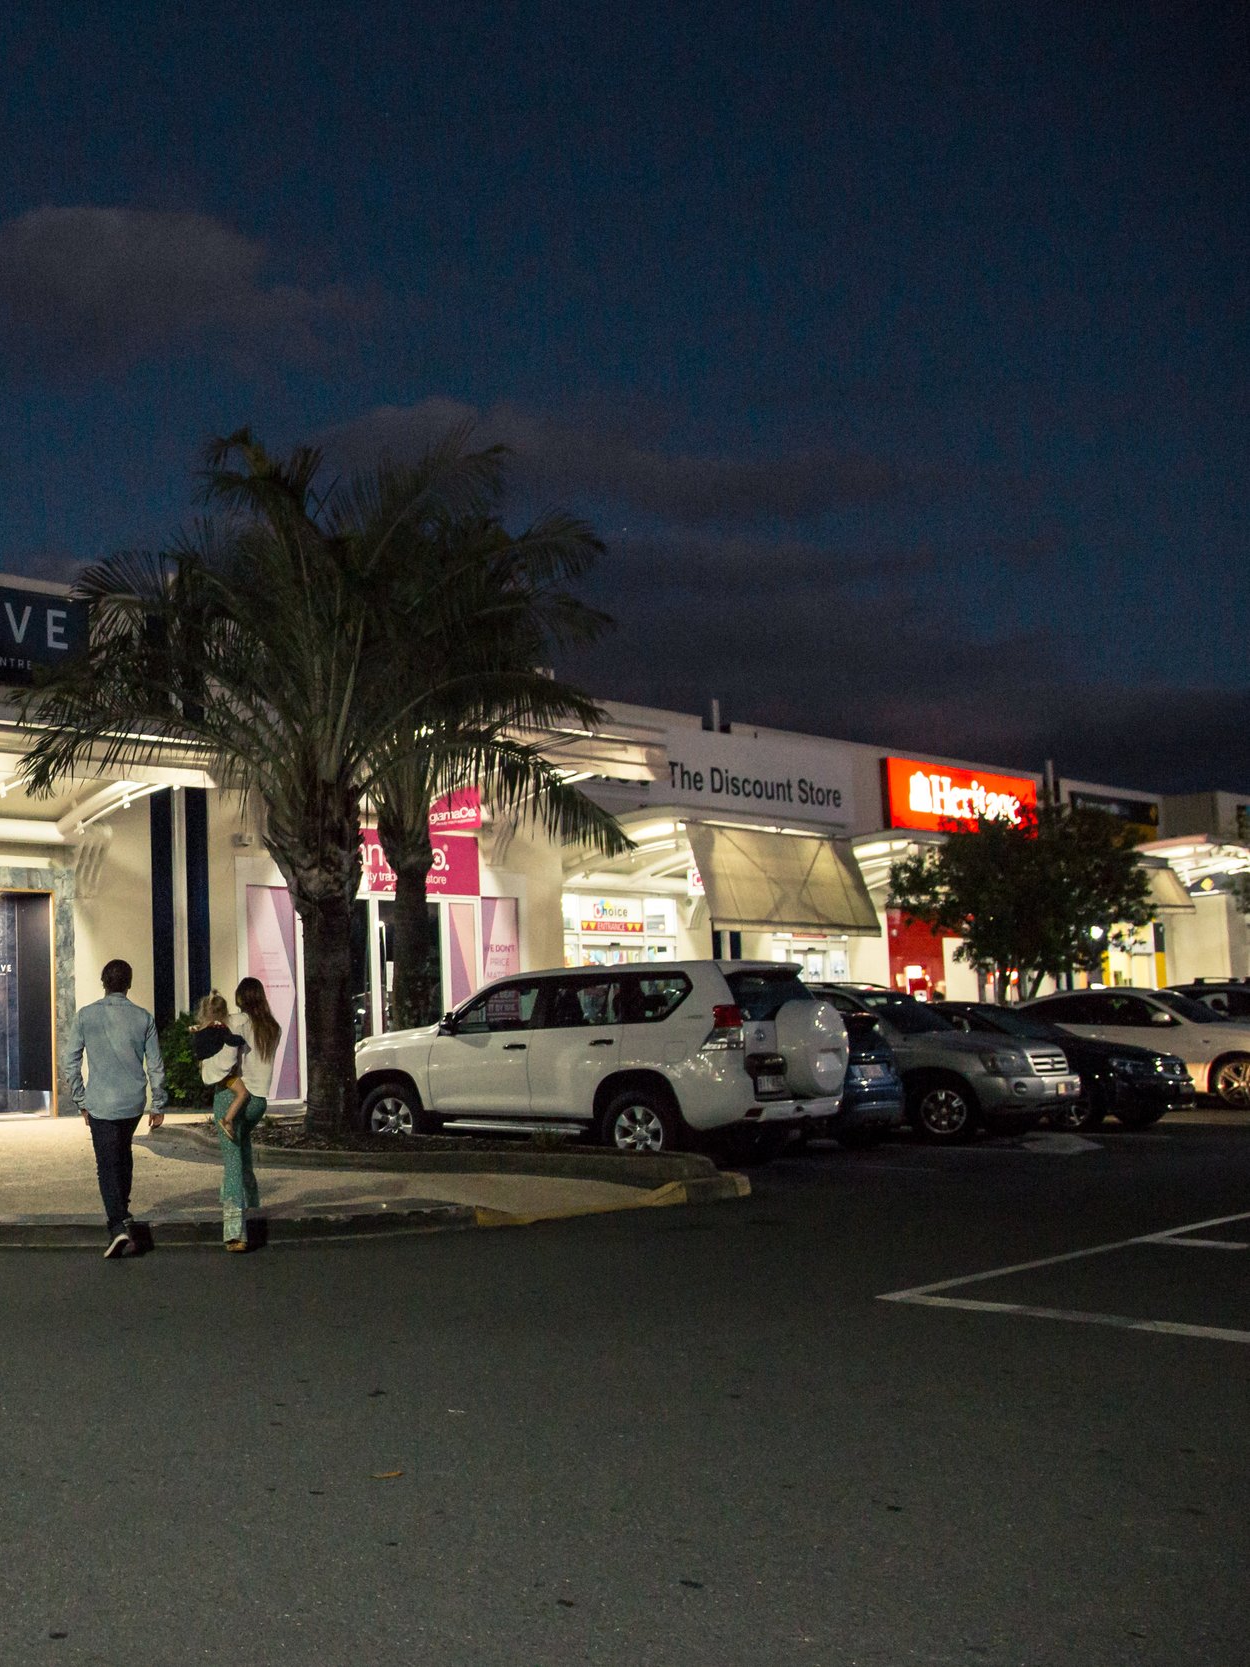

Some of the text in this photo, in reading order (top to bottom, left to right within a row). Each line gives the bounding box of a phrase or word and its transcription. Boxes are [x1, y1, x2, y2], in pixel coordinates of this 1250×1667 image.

[668, 761, 842, 808] The Discount Store
[597, 923, 625, 932] ENTRANCE
